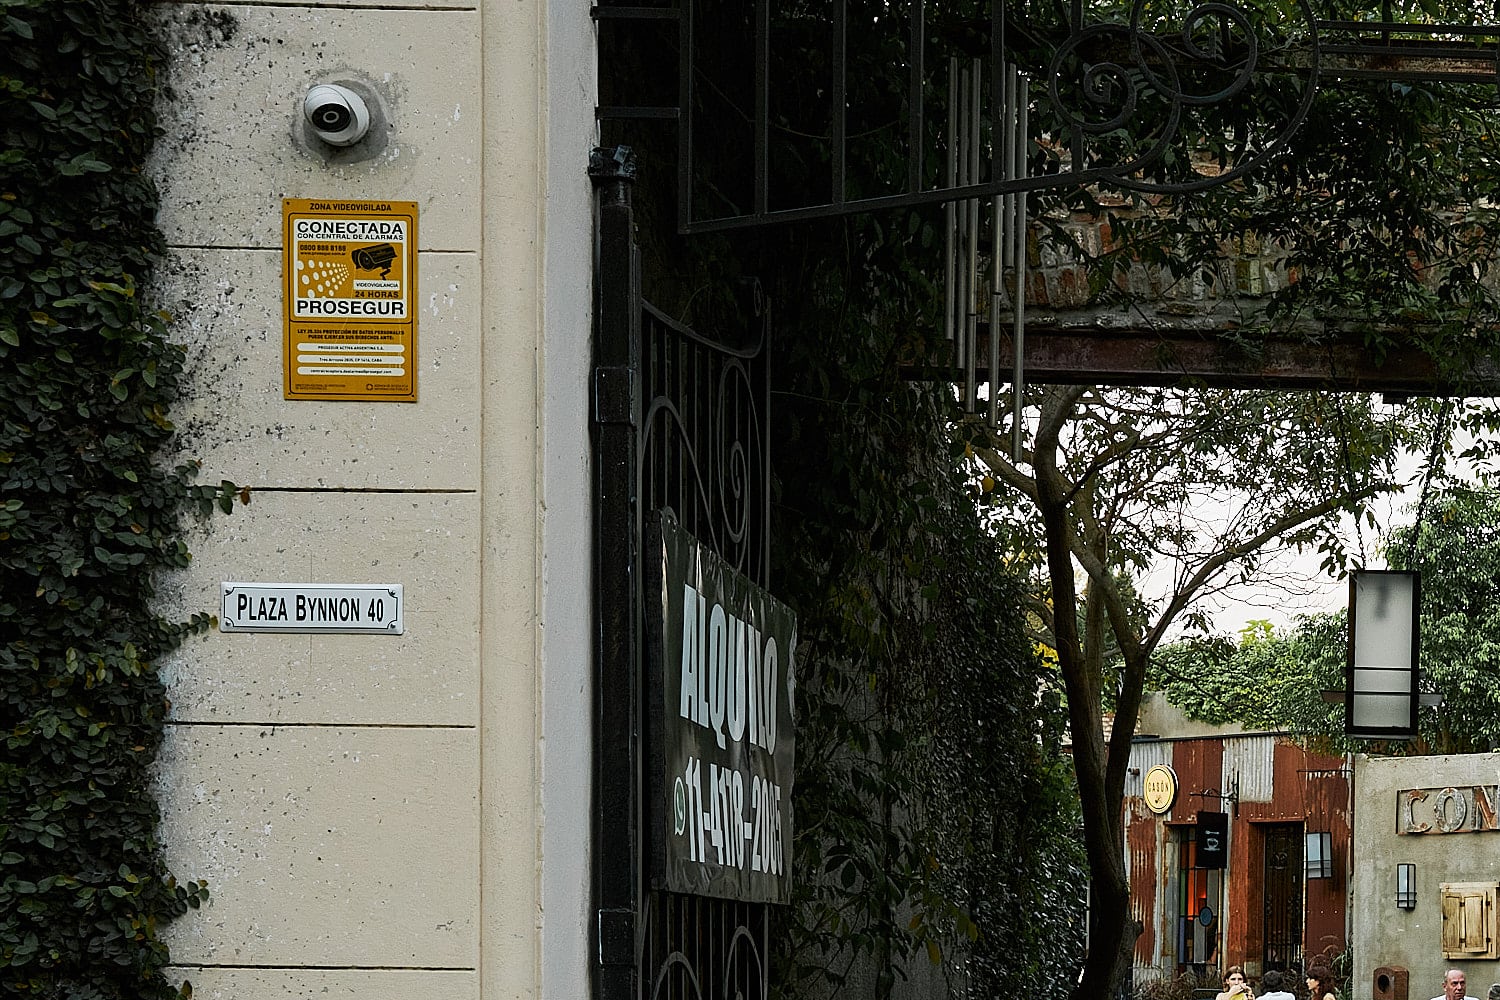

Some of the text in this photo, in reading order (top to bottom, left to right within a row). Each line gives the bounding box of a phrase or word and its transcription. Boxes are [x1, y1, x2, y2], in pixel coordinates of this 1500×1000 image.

[309, 202, 392, 212] ZONA VIDEOVIGILADA
[297, 221, 403, 235] CONECTADA
[299, 244, 316, 252] 0800
[355, 290, 400, 299] 24 HORAS
[297, 300, 404, 316] PROSEGUR
[237, 593, 384, 623] PLAZA BYNNON 40
[680, 583, 778, 755] ALQUILO
[685, 756, 783, 876] 11-4178-2085
